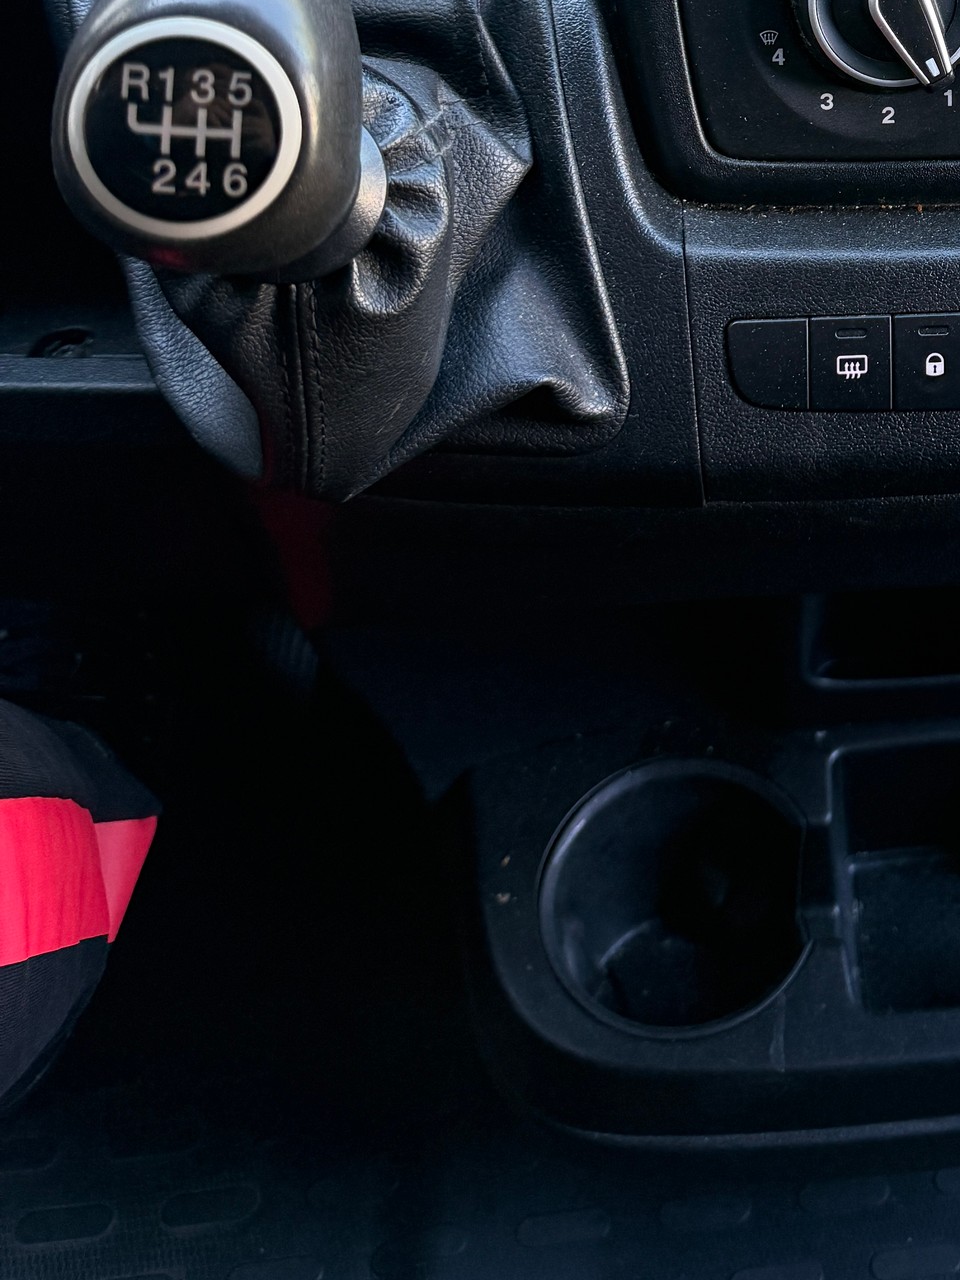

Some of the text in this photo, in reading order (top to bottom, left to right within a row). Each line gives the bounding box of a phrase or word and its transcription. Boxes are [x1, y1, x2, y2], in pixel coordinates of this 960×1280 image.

[771, 48, 786, 65] 4
[820, 93, 834, 110] 3
[943, 90, 953, 107] 1
[881, 107, 896, 124] 2
